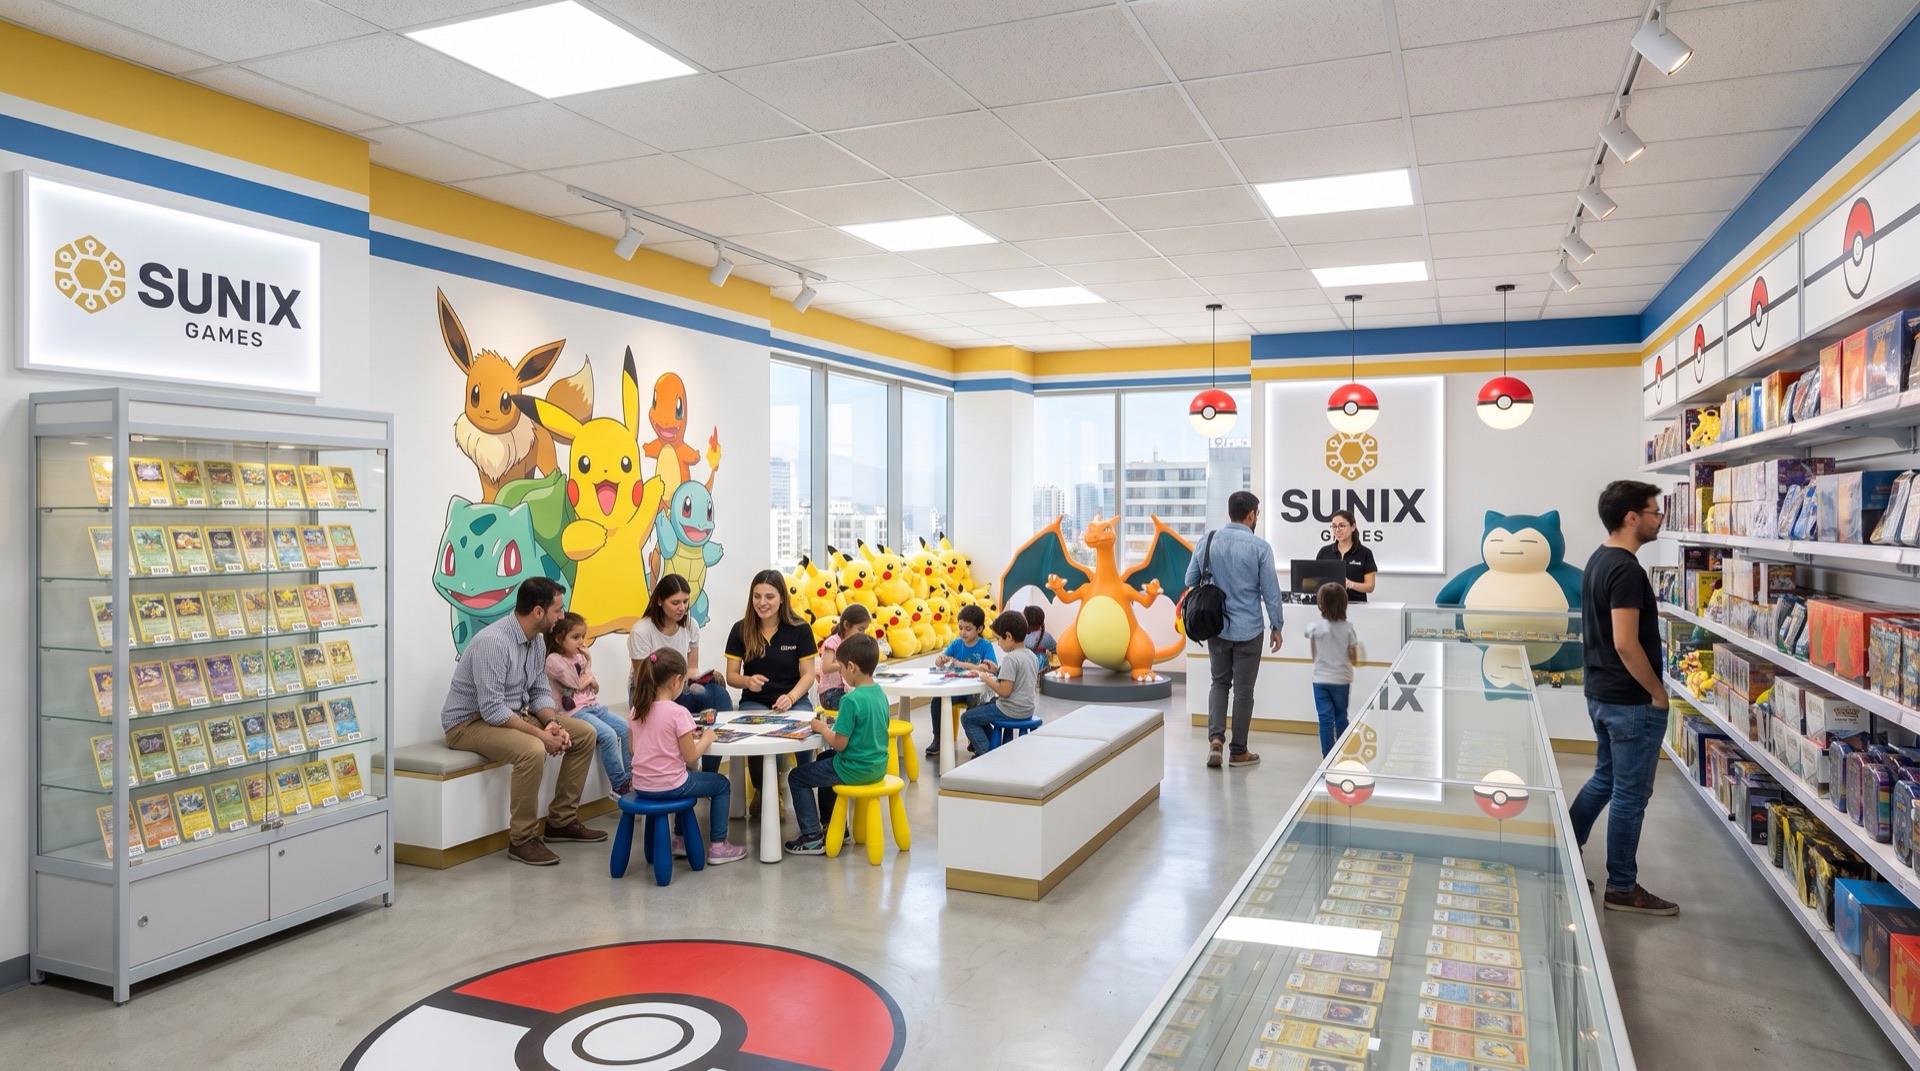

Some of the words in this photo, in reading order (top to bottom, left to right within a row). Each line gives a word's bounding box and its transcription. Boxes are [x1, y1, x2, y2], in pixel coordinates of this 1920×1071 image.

[138, 262, 302, 330] SUNIX
[185, 322, 264, 348] GAMES
[1281, 489, 1426, 523] SUNIX
[1321, 530, 1384, 542] GES
